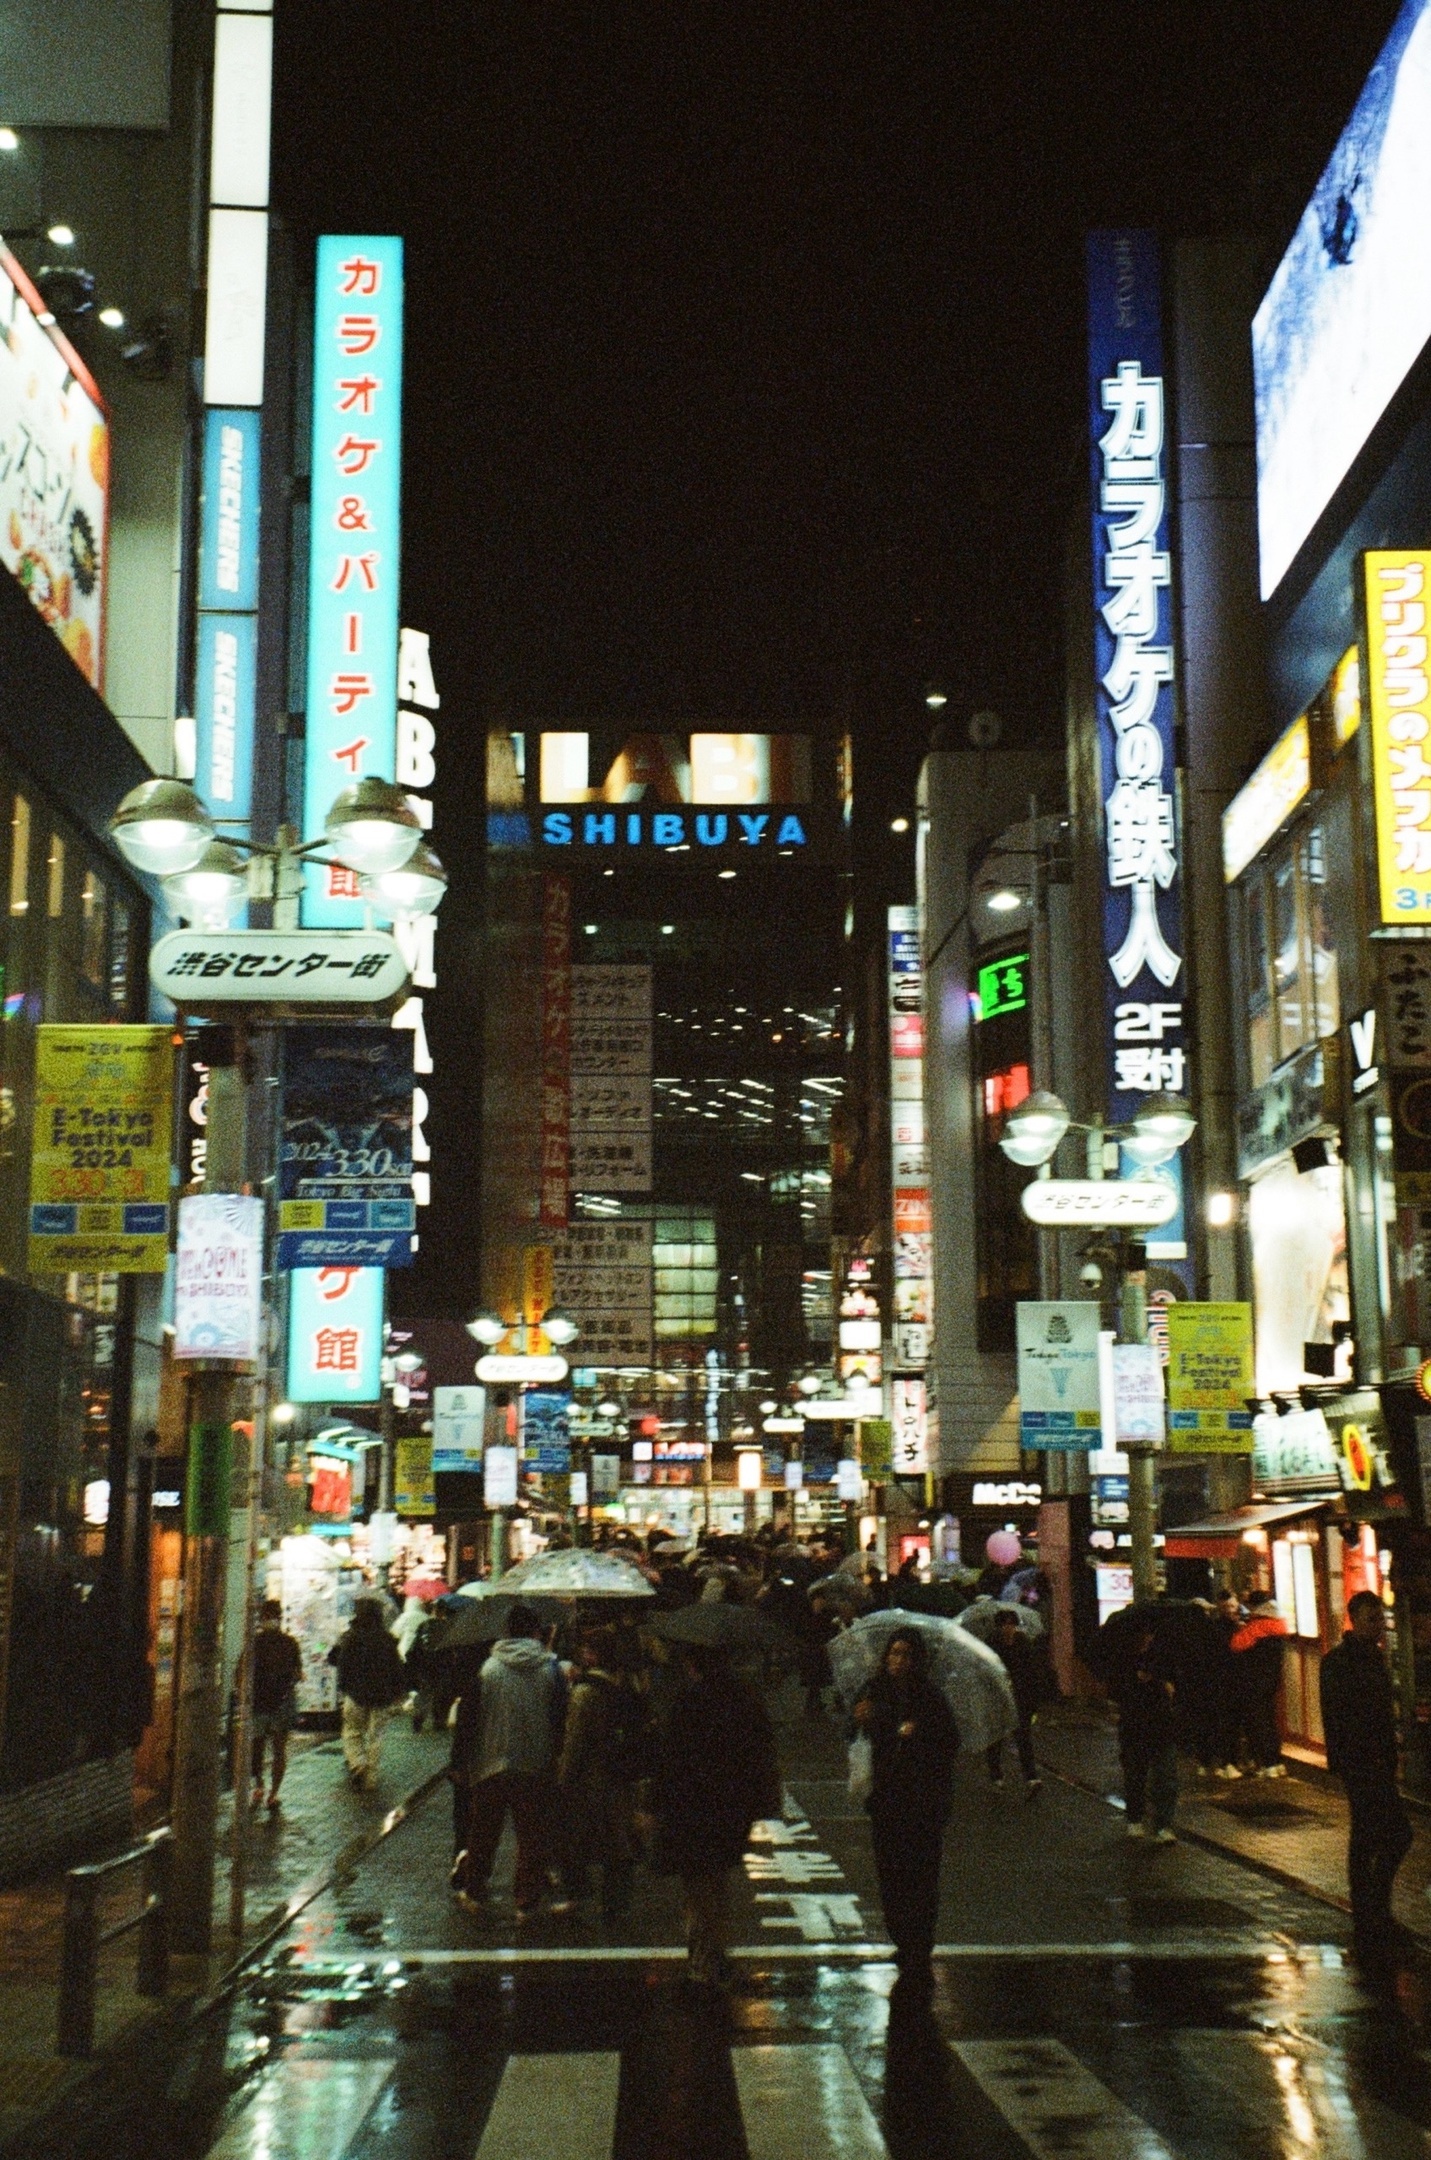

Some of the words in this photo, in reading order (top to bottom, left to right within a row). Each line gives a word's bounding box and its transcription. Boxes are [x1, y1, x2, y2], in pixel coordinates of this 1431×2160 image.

[1100, 360, 1181, 988] カラオケの鉄人
[541, 812, 807, 846] SHIBUYA
[166, 952, 393, 979] 渋谷センター街
[1114, 1003, 1183, 1041] 2F
[1114, 1049, 1185, 1093] 受付
[52, 1128, 154, 1147] Festival
[72, 1148, 134, 1168] 2024
